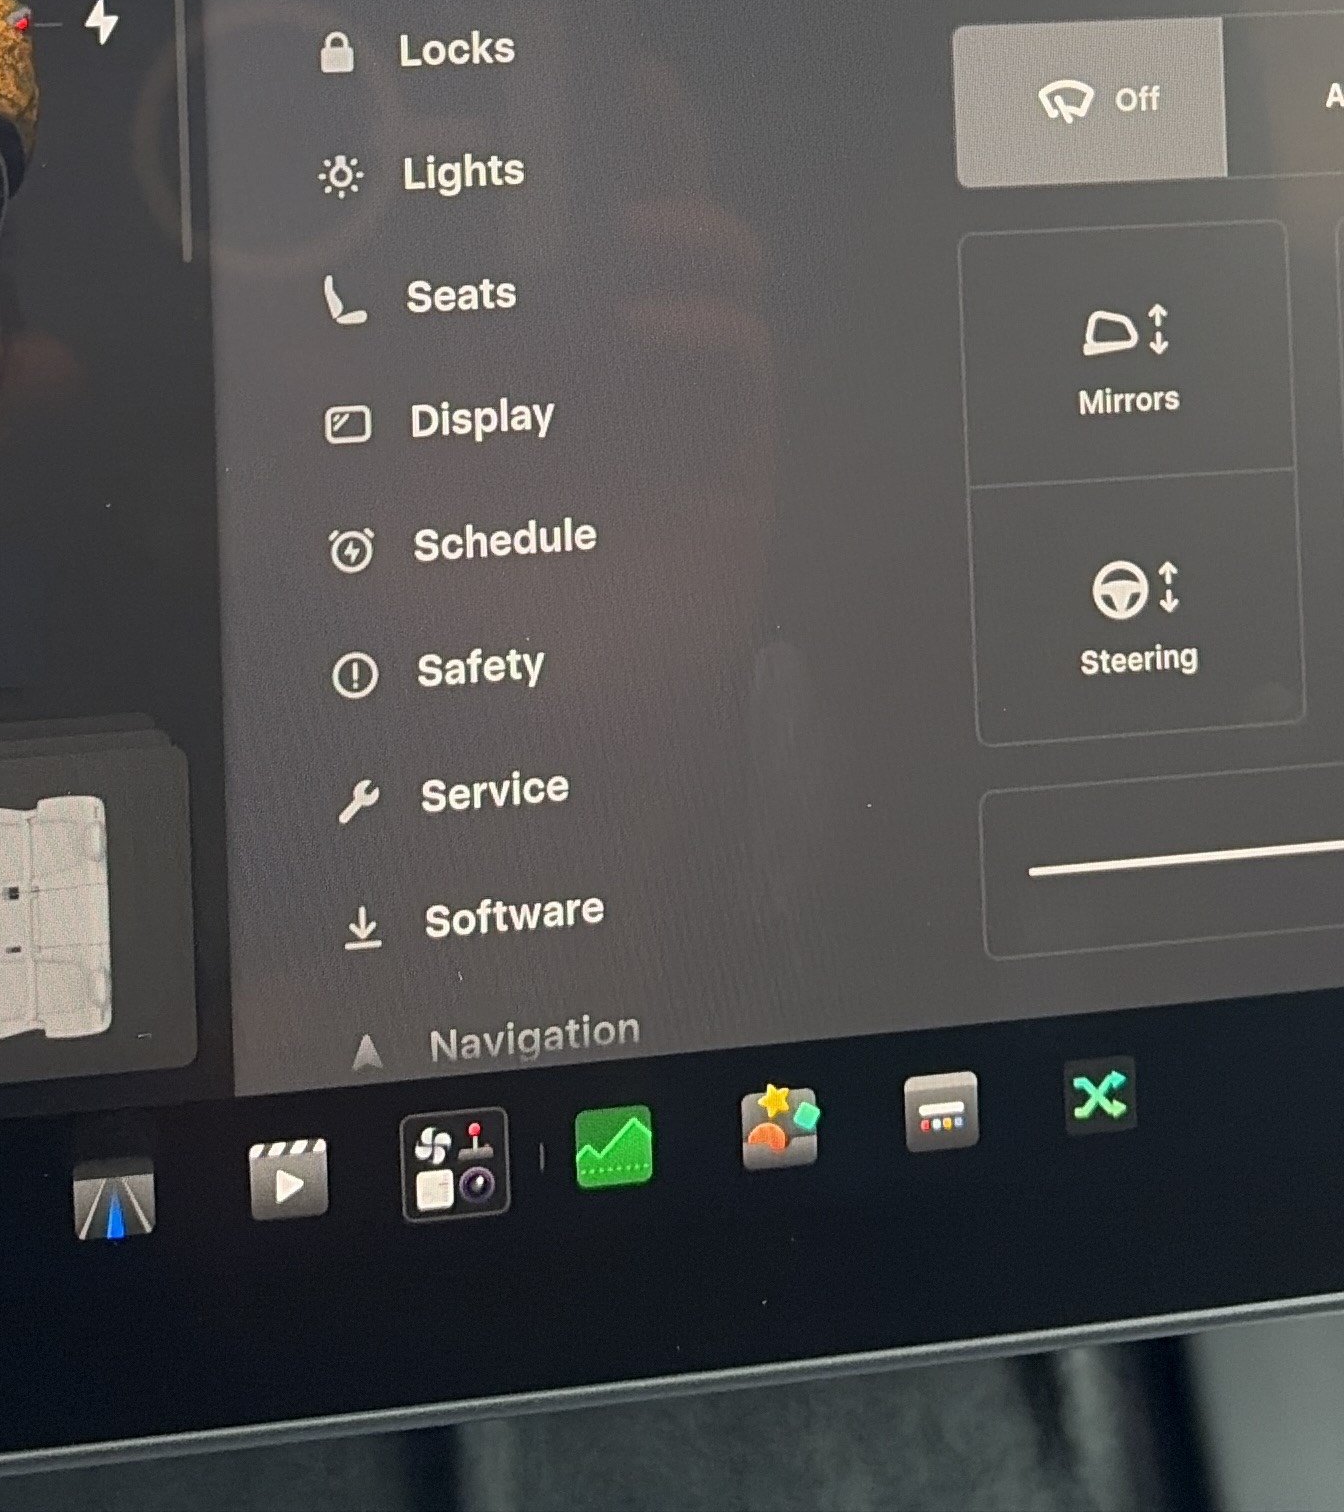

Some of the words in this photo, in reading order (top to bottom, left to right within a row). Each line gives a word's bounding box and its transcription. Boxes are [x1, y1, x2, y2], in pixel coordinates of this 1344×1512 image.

[400, 30, 516, 67] Locks
[1115, 84, 1161, 112] Off
[404, 153, 525, 197] Lights
[406, 278, 517, 313] Seats
[411, 397, 555, 443] Display
[1078, 387, 1180, 416] Mirrors
[414, 517, 597, 562] Schedule
[417, 648, 545, 688] Safety
[1080, 643, 1198, 676] Steering
[421, 770, 569, 813] Service
[425, 897, 605, 939] Software
[430, 1014, 640, 1062] Navigation
